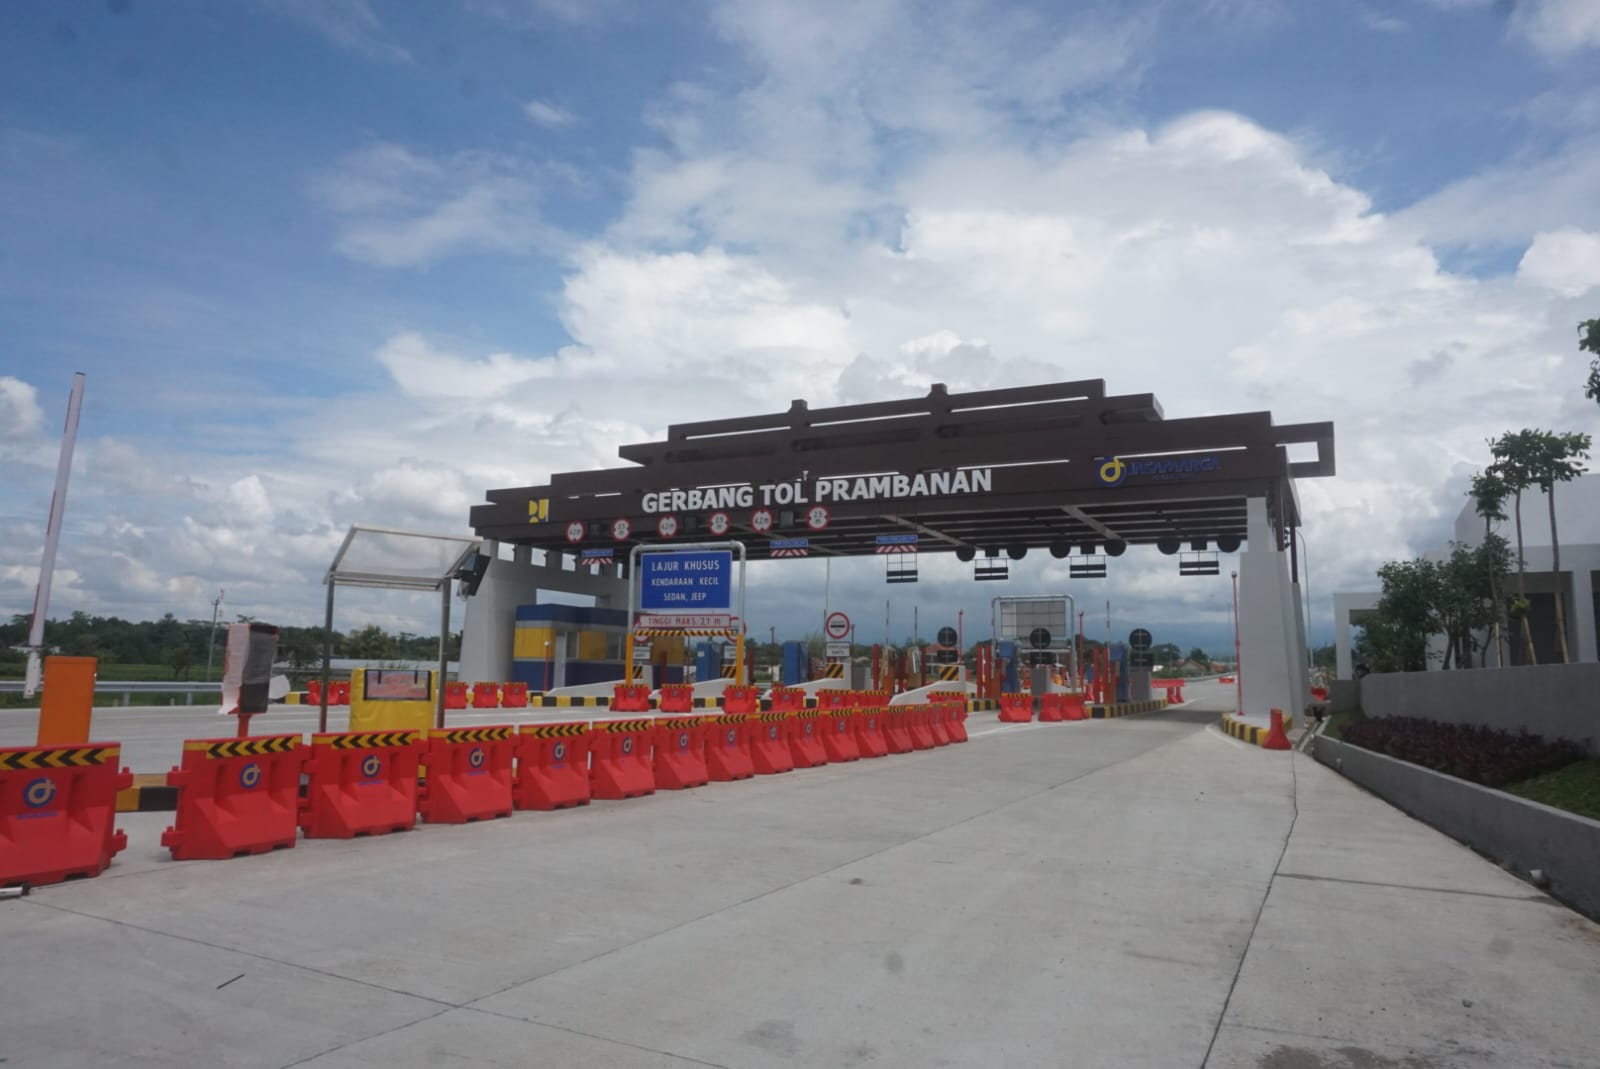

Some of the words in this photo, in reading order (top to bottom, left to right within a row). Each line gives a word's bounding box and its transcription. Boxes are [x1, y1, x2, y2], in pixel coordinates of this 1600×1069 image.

[641, 485, 754, 514] GERBANG
[759, 482, 808, 506] TOL
[815, 468, 993, 502] PRAMBANAN
[651, 561, 679, 572] LAJUR
[684, 559, 720, 571] KHUSUS
[651, 577, 693, 587] KENDARAAN
[699, 576, 719, 586] KECIL
[663, 592, 688, 602] SEDAN,
[691, 592, 707, 601] JEEP
[648, 617, 672, 626] TINGGI
